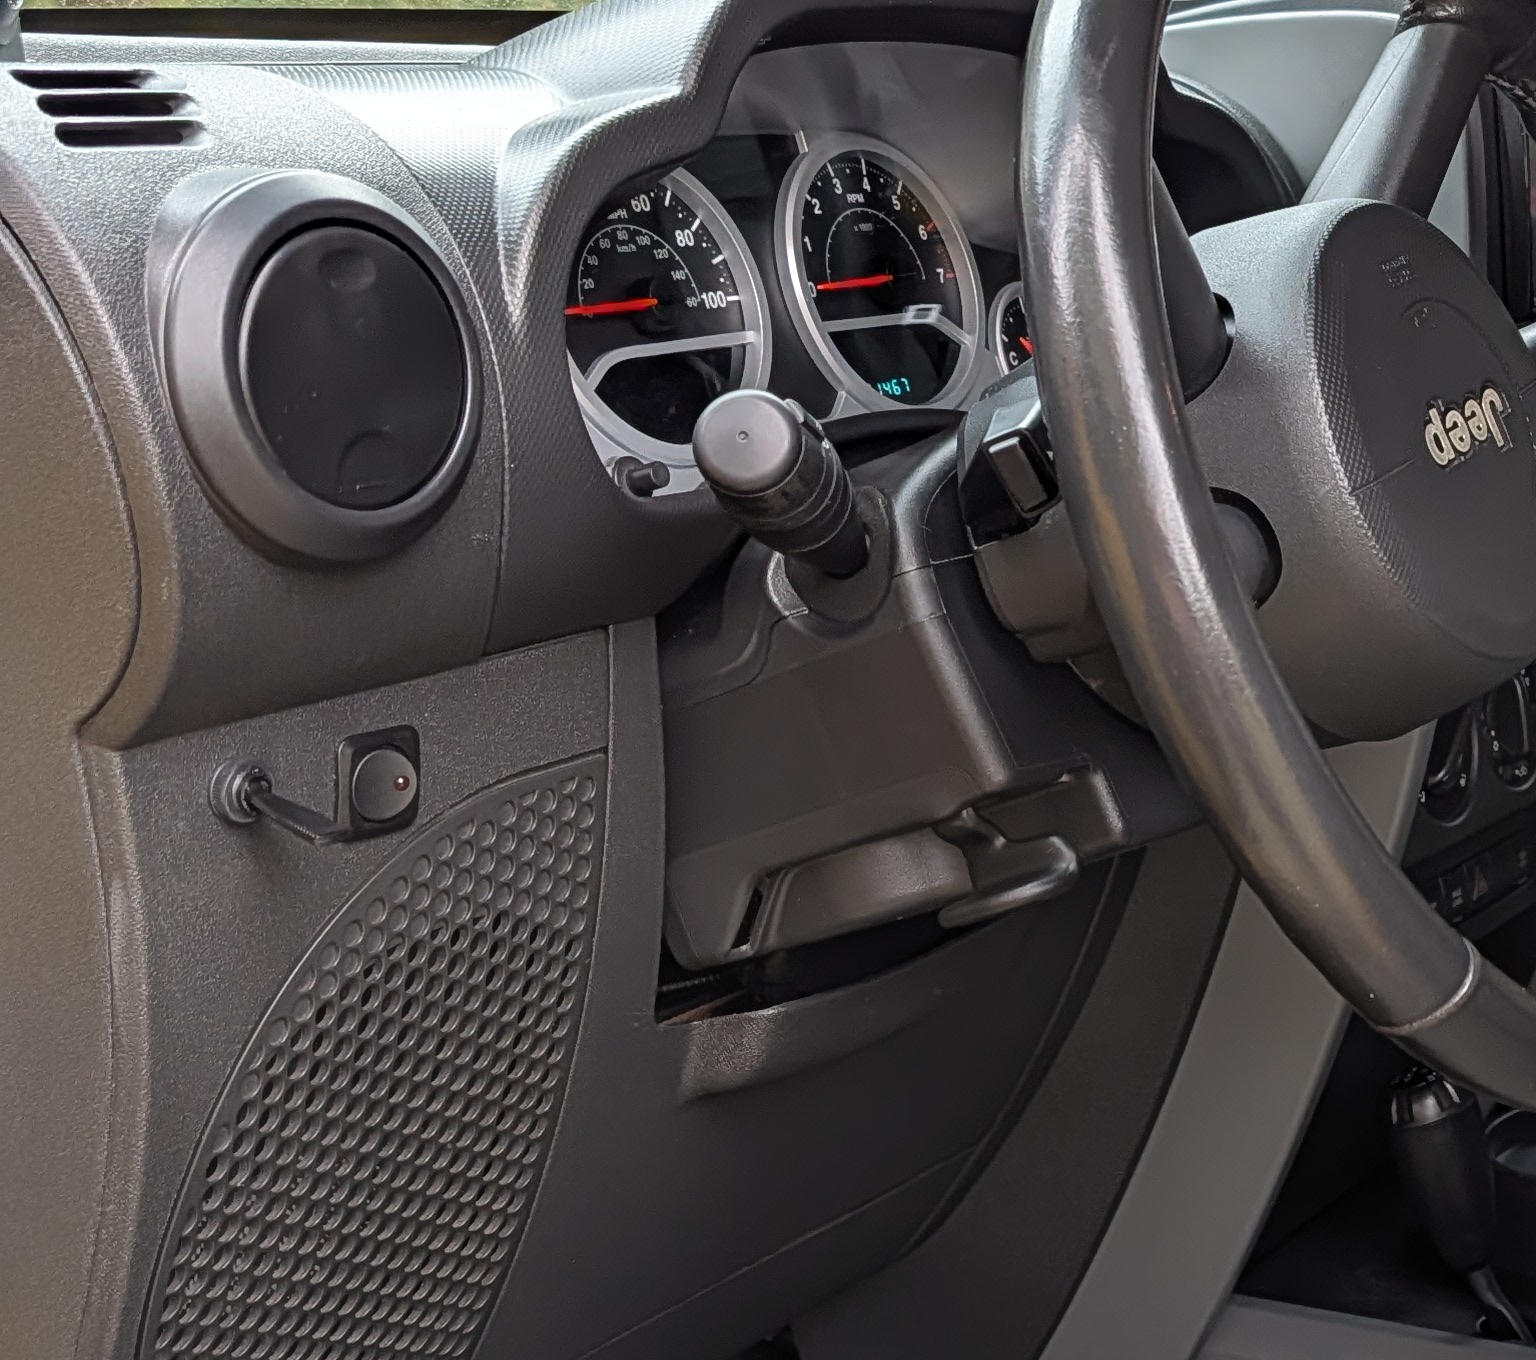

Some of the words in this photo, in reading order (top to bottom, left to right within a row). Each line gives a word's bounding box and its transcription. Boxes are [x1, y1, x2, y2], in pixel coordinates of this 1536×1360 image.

[832, 178, 843, 195] 3
[862, 177, 871, 192] 4
[630, 193, 651, 213] 60
[846, 193, 865, 204] RPM
[891, 195, 901, 211] 5
[811, 199, 823, 214] 2
[617, 230, 628, 241] 80
[675, 229, 694, 248] 80
[918, 225, 928, 240] 6
[600, 238, 611, 249] 60
[635, 235, 651, 246] 100
[804, 235, 813, 252] 1
[616, 244, 637, 253] km/h
[653, 249, 669, 259] 120
[587, 255, 598, 266] 40
[671, 270, 686, 280] 140
[936, 268, 945, 283] 7
[583, 278, 595, 290] 20
[701, 292, 727, 310] 100
[1008, 352, 1019, 366] C
[1425, 387, 1505, 466] Jeep
